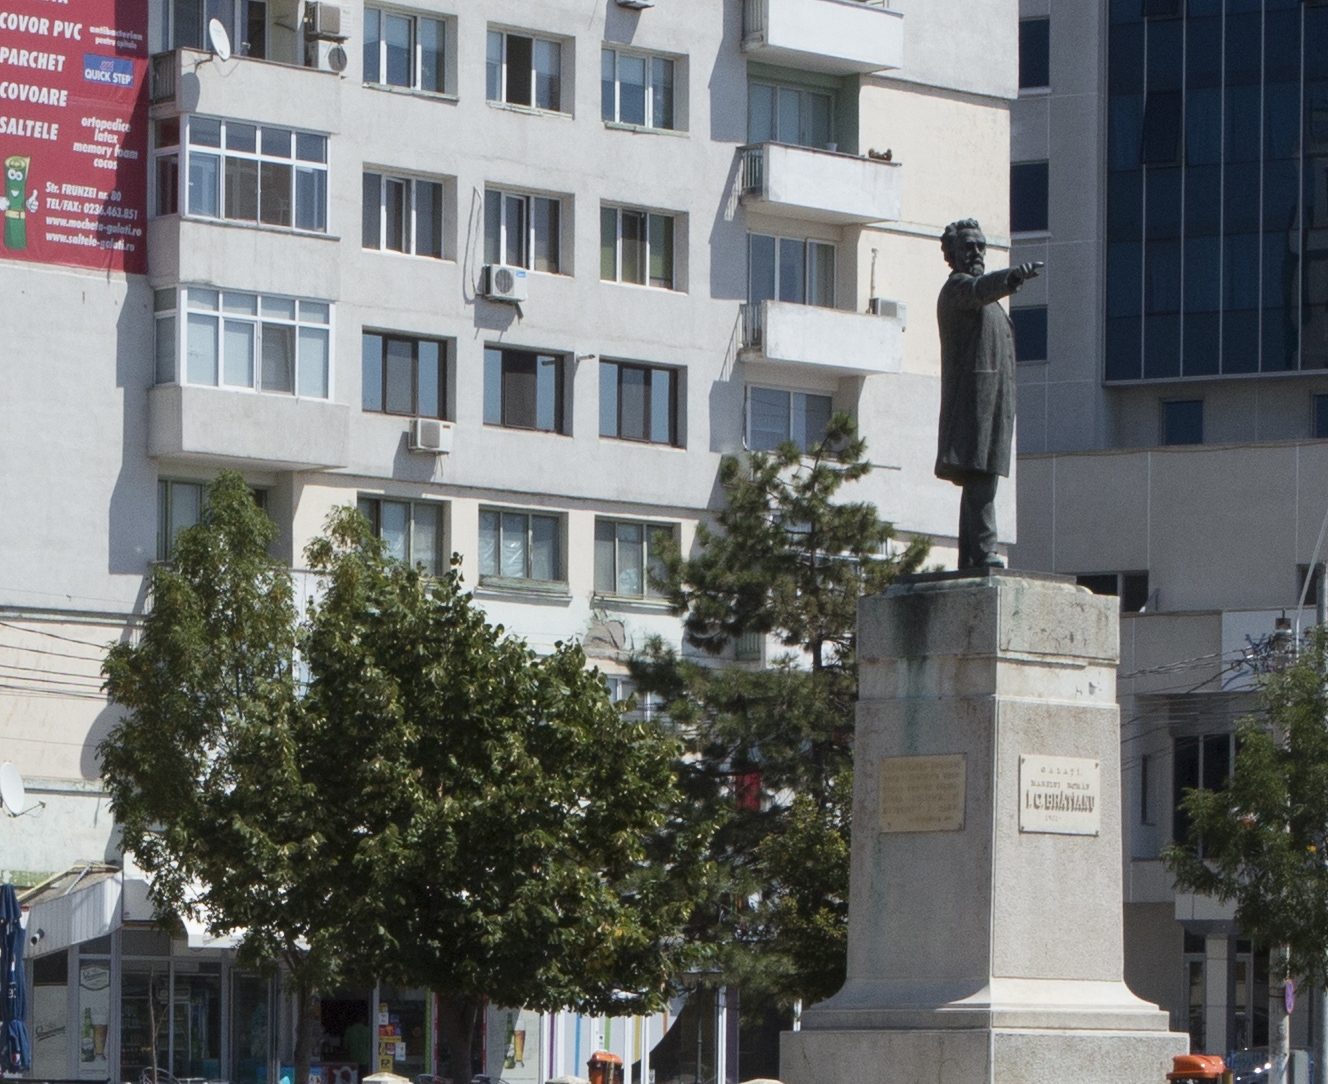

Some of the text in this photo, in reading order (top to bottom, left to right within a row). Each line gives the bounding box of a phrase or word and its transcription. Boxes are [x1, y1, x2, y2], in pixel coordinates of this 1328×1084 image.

[52, 20, 83, 41] PVC
[84, 68, 132, 85] QUICK STEP
[0, 81, 68, 107] COVOARE
[81, 117, 131, 133] ortopedice
[94, 129, 119, 144] latex
[73, 142, 138, 159] memory foam
[93, 158, 118, 170] cocos
[45, 181, 60, 194] Str.
[61, 183, 98, 199] FRUNZEI
[45, 198, 82, 214] TEL/FAX:
